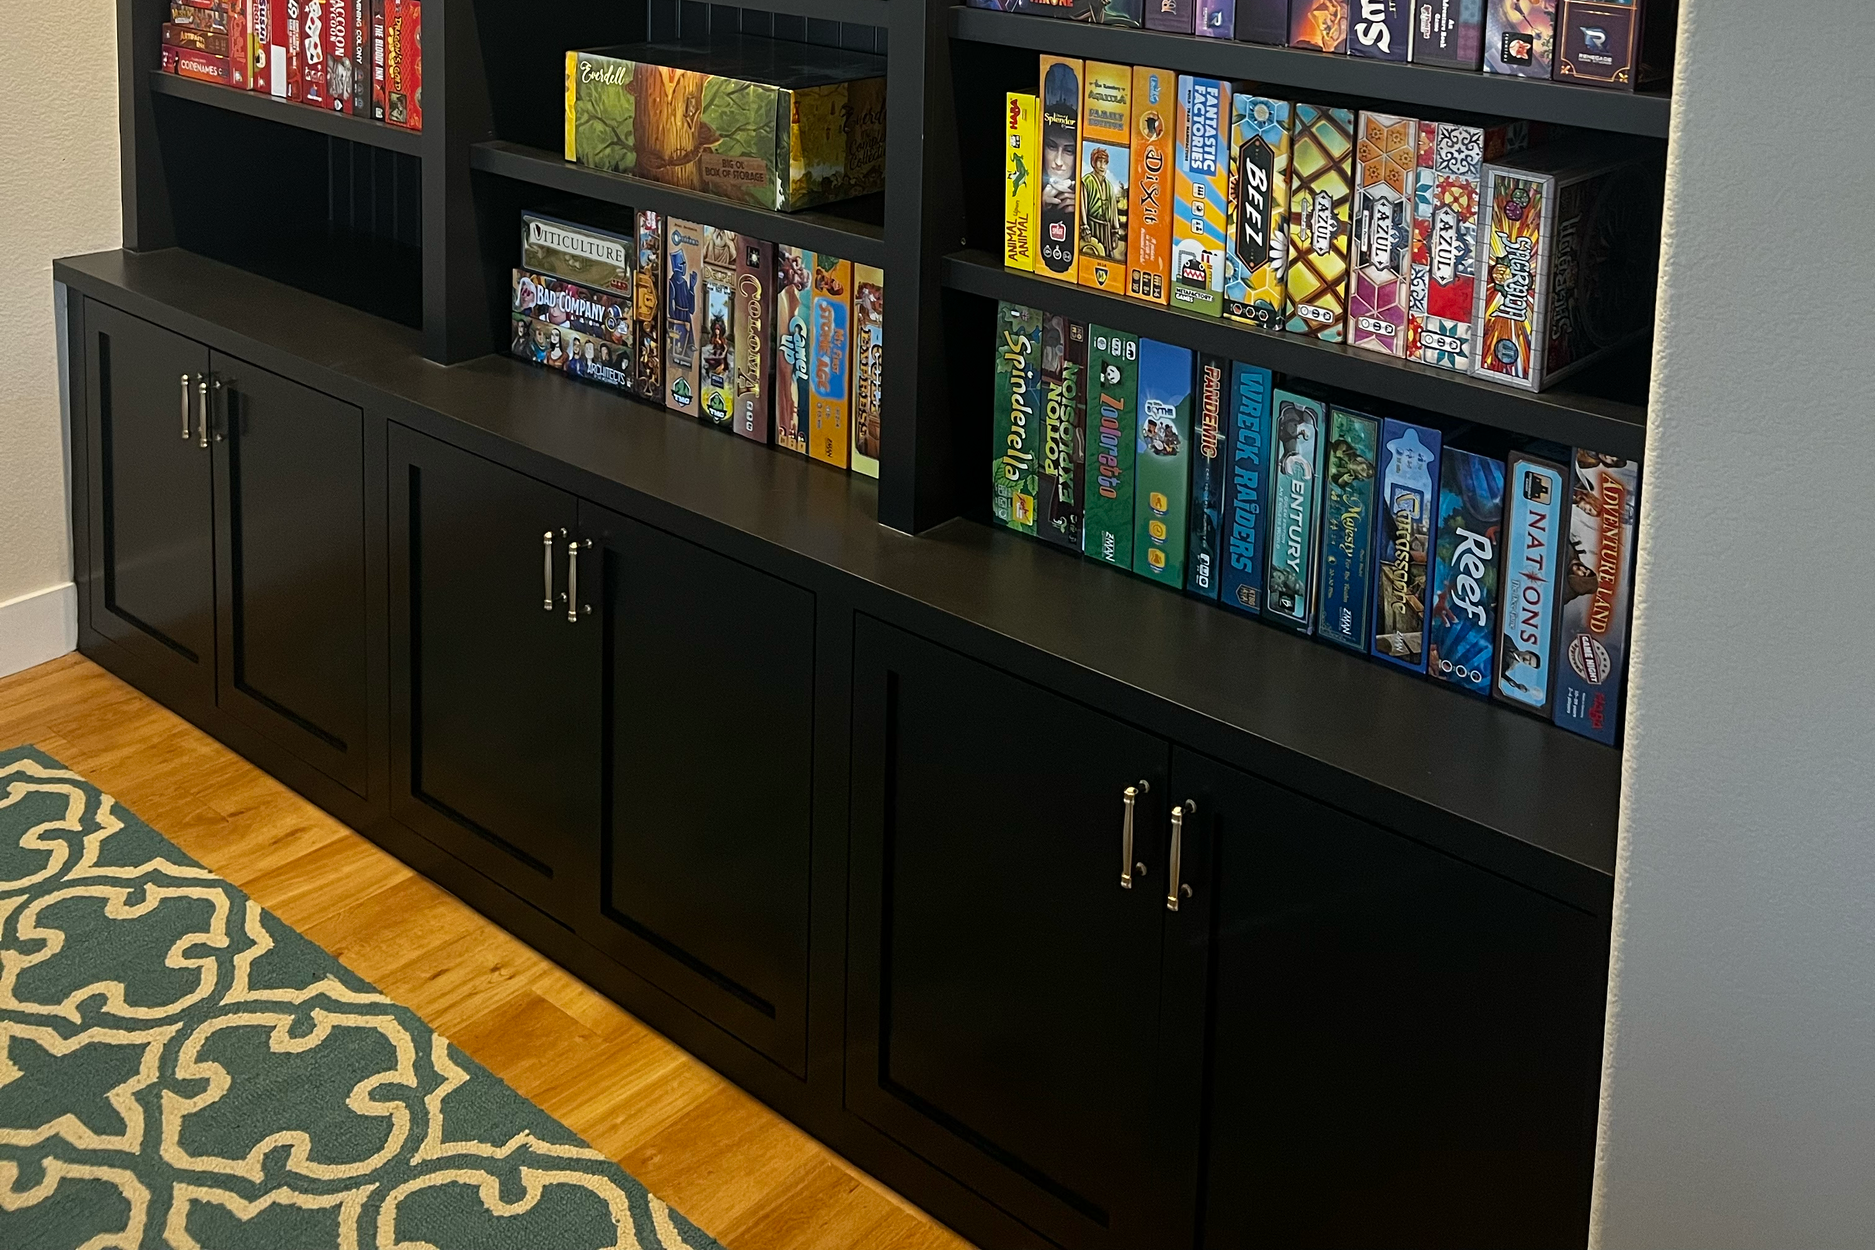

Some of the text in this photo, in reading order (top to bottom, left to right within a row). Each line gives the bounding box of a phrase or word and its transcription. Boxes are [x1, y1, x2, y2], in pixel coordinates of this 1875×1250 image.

[374, 24, 383, 37] THE
[1578, 52, 1613, 62] RENEGADE
[181, 59, 218, 76] CODENAMES
[375, 66, 384, 81] INN
[580, 61, 626, 86] Everdell
[1009, 98, 1022, 130] HABA
[1044, 112, 1076, 126] Splendor
[1191, 85, 1206, 170] FACTORIES
[1203, 87, 1219, 172] FANTASTIC
[705, 166, 764, 182] BOX OF STORAGE
[722, 158, 734, 169] BIG
[1244, 157, 1269, 248] BEEZ
[1315, 202, 1329, 244] AZUL
[533, 223, 623, 263] VITICULTURE
[1006, 218, 1018, 261] ANIMAL
[1018, 213, 1029, 258] ANIMAL
[1374, 209, 1390, 257] AZUL
[1437, 218, 1454, 271] AZUL
[537, 285, 605, 322] BAD COMPANY
[1175, 288, 1214, 301] METAFACTORY
[1489, 231, 1532, 322] SAGRADA
[738, 273, 762, 399] COLOMA
[779, 335, 796, 364] Up
[789, 315, 809, 380] Camel
[816, 303, 834, 391] STONE AGE
[587, 362, 626, 385] ARCHITECTS
[859, 327, 871, 438] EXPRESS
[1004, 330, 1032, 481] Spinderella
[1045, 382, 1062, 477] POTION
[1058, 360, 1081, 506] EXPLOSION
[1200, 365, 1221, 459] PANDEMIC
[1098, 393, 1124, 498] Zooloretto
[1230, 371, 1263, 574] WRECK RAIDERS
[1282, 450, 1312, 573] CENTURY
[1339, 496, 1363, 558] Majesty
[1394, 493, 1420, 615] Carcassonne
[1452, 527, 1493, 627] Reef
[1519, 509, 1548, 647] NATIONS
[1590, 473, 1623, 633] ADVENTURE LAND
[1582, 636, 1598, 683] GAME NIGHT
